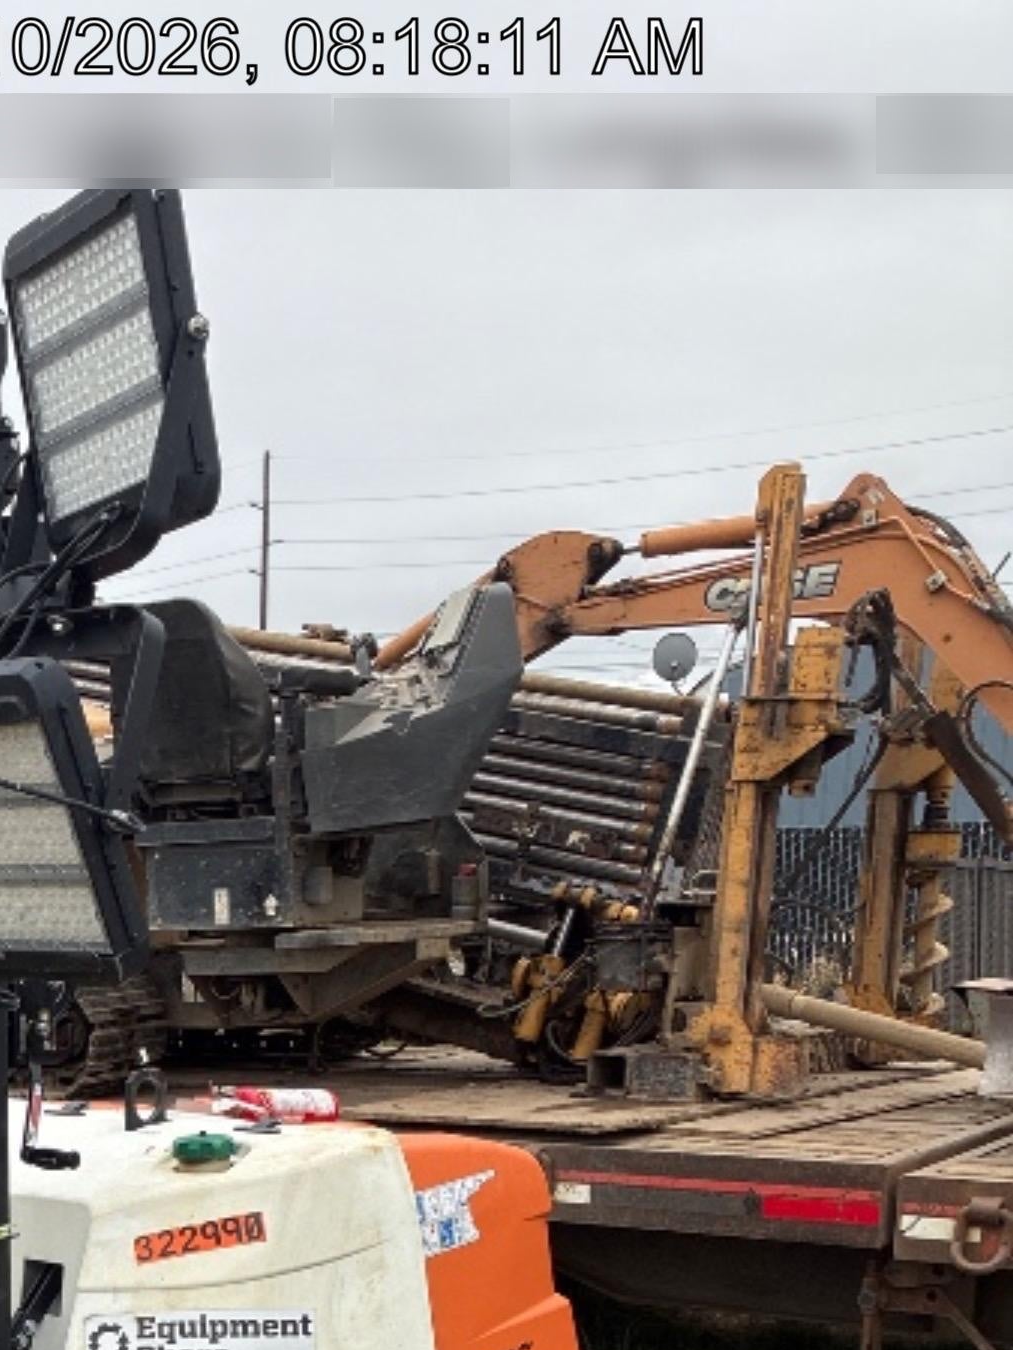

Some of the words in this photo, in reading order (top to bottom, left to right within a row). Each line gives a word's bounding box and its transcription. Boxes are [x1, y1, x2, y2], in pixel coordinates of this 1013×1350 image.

[704, 560, 841, 612] CE
[134, 1212, 263, 1262] 322990
[135, 1313, 312, 1345] Equipment
